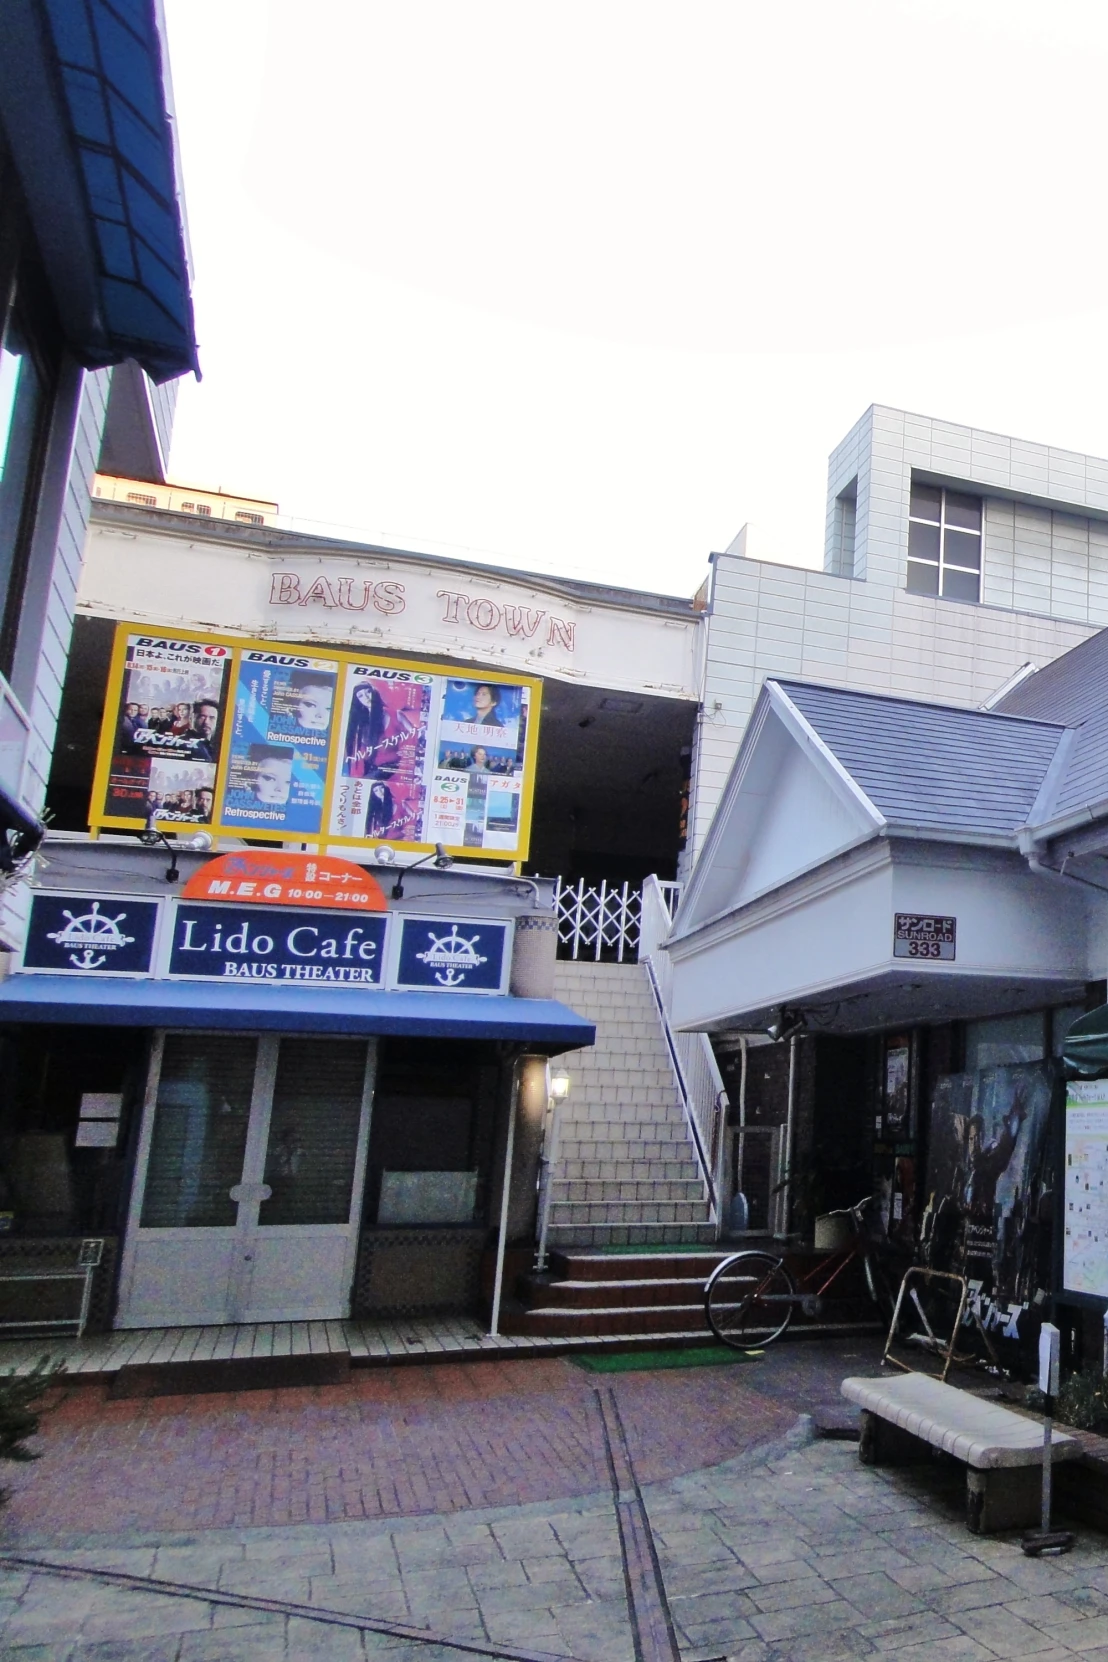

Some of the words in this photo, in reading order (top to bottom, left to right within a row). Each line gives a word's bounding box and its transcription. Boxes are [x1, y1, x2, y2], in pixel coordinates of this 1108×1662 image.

[269, 573, 405, 616] BAUS
[437, 590, 577, 653] TOWN
[136, 638, 202, 653] BAUS
[248, 652, 309, 667] BAUS
[353, 667, 411, 681] BAUS
[267, 731, 327, 746] Retrospective
[434, 775, 468, 783] BAUS
[224, 807, 286, 820] Retrospective
[319, 872, 363, 884] コーナー
[208, 880, 282, 898] M.E.G
[898, 917, 952, 933] サンロード
[179, 920, 275, 956] Lido
[287, 925, 377, 960] Cafe
[897, 930, 952, 942] SUNROAD
[909, 941, 941, 957] 333
[223, 962, 278, 979] BAUS
[281, 964, 374, 982] THEATER
